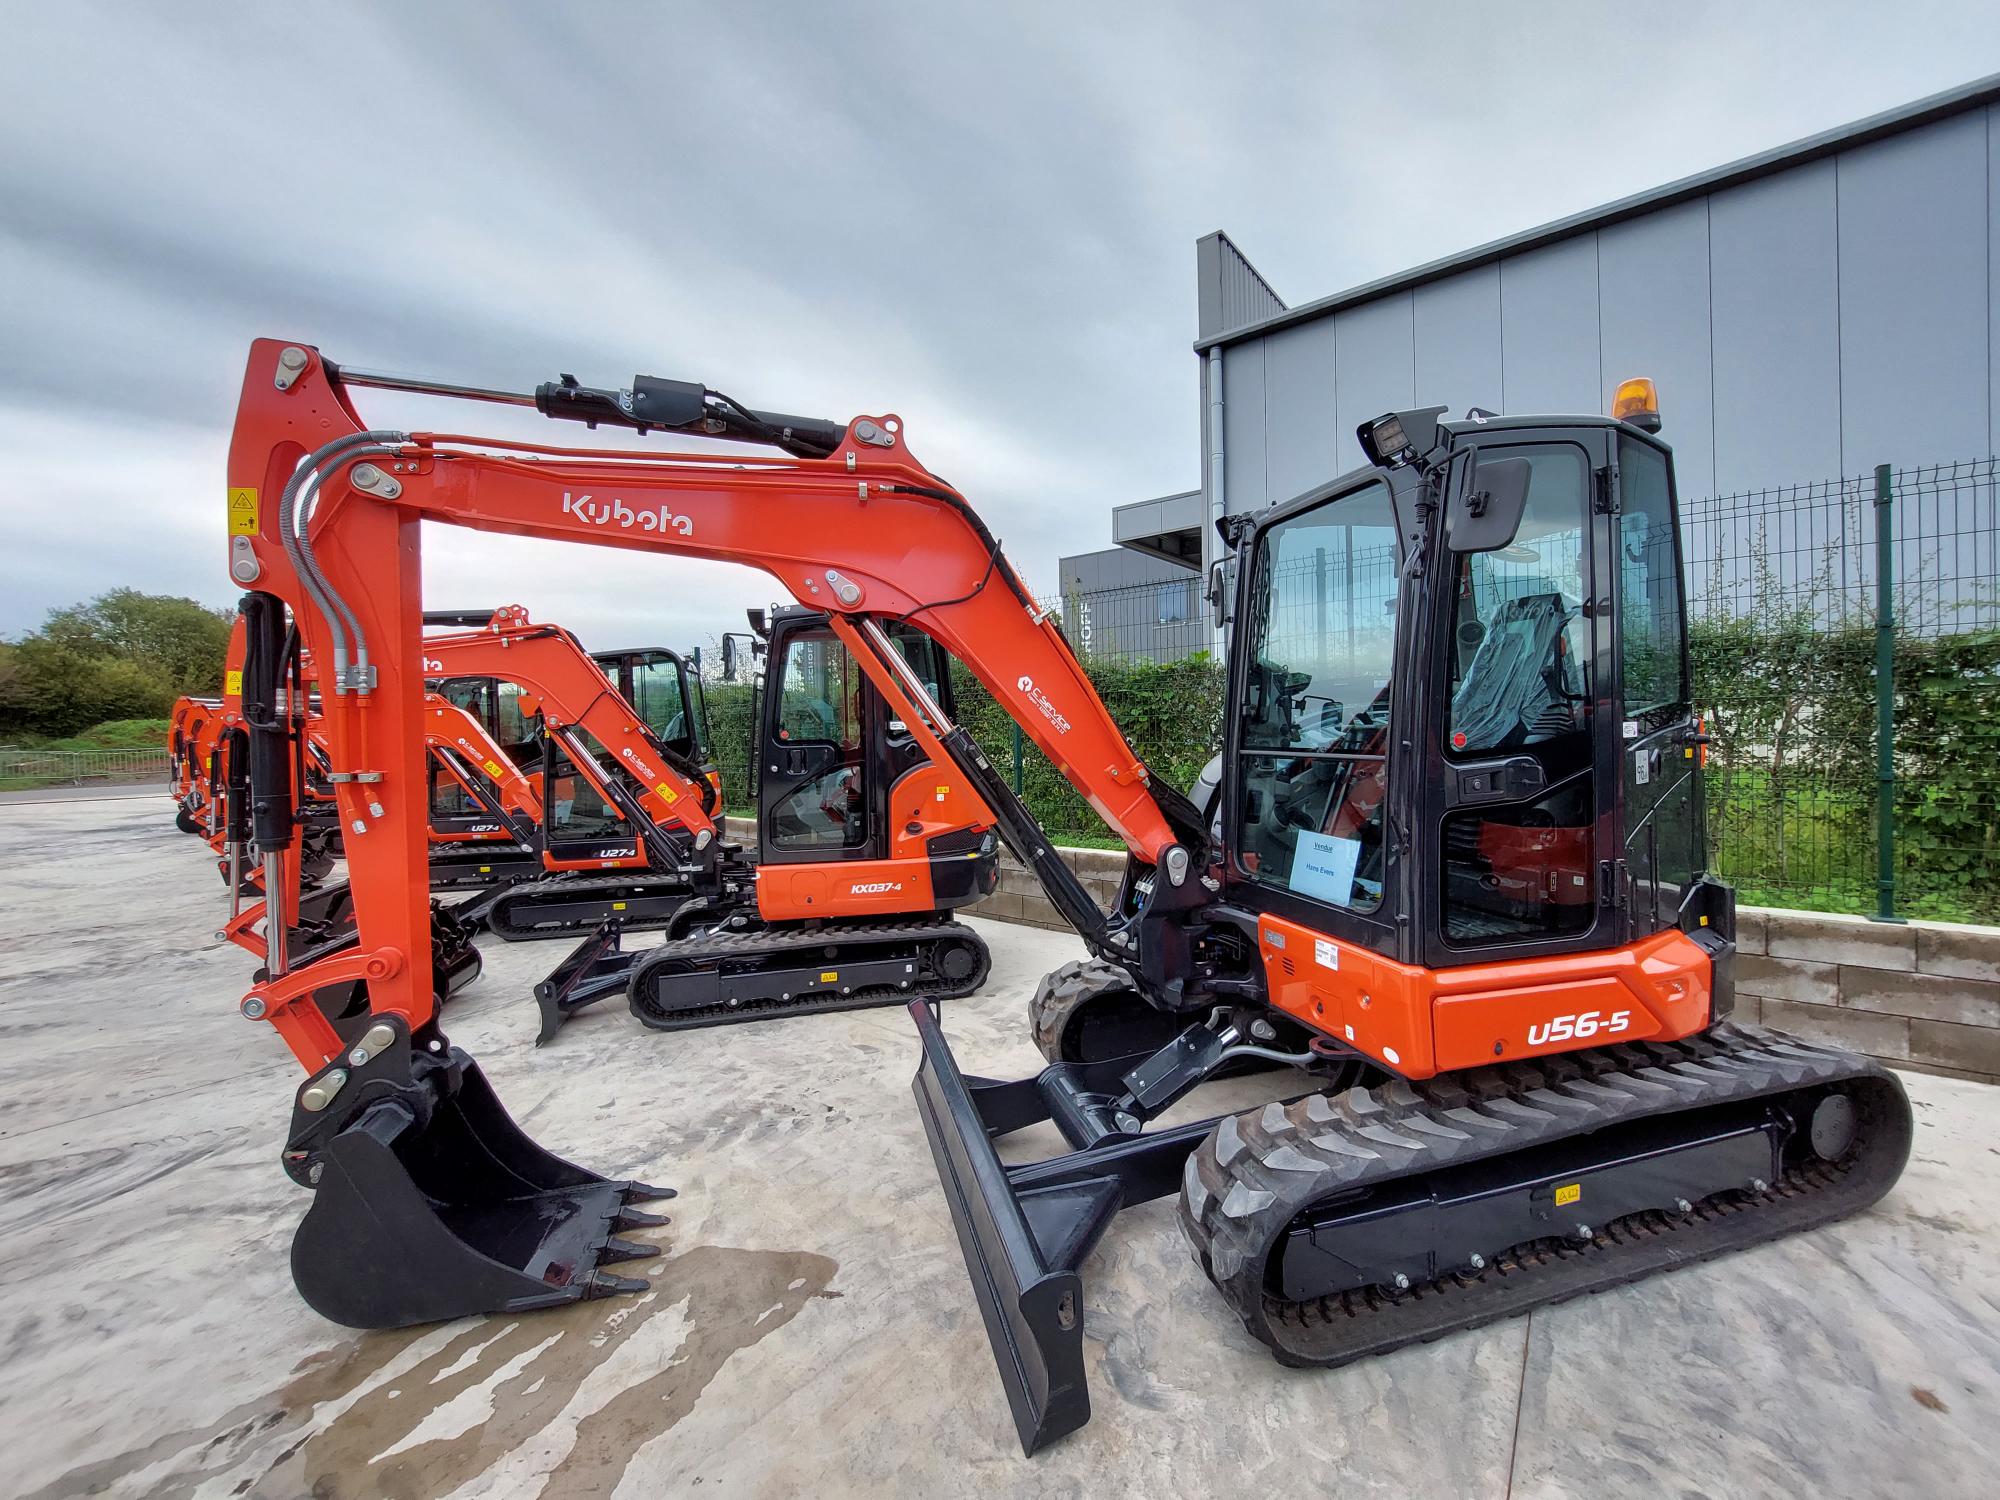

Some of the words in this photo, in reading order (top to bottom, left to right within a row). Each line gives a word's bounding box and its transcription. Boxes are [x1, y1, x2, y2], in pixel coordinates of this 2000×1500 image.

[563, 492, 693, 536] Kubota
[600, 848, 636, 858] U27-4
[851, 882, 902, 894] KX037-4
